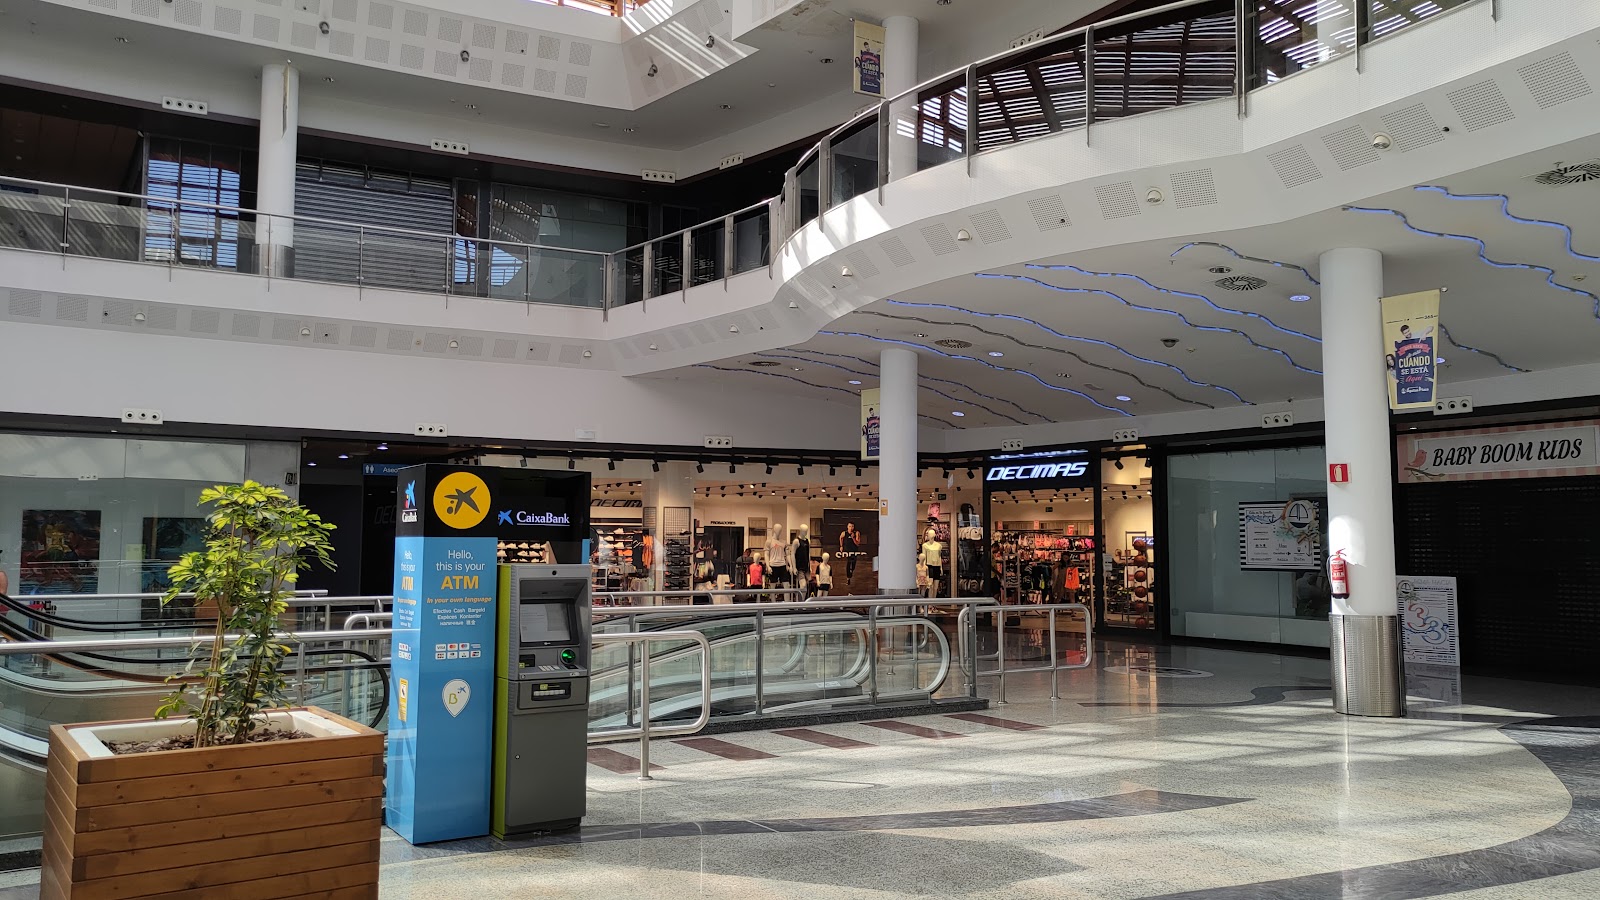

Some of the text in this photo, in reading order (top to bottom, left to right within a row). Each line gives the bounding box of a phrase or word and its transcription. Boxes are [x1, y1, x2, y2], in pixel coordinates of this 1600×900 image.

[1398, 356, 1430, 368] CUANDO
[1432, 438, 1583, 467] BABY BOOM KIDS
[986, 462, 1090, 481] DECIMAS
[516, 511, 570, 524] CaixaBank
[448, 550, 474, 560] Hello,
[436, 562, 485, 572] this is your
[401, 576, 414, 591] ATM
[441, 576, 479, 590] ATM
